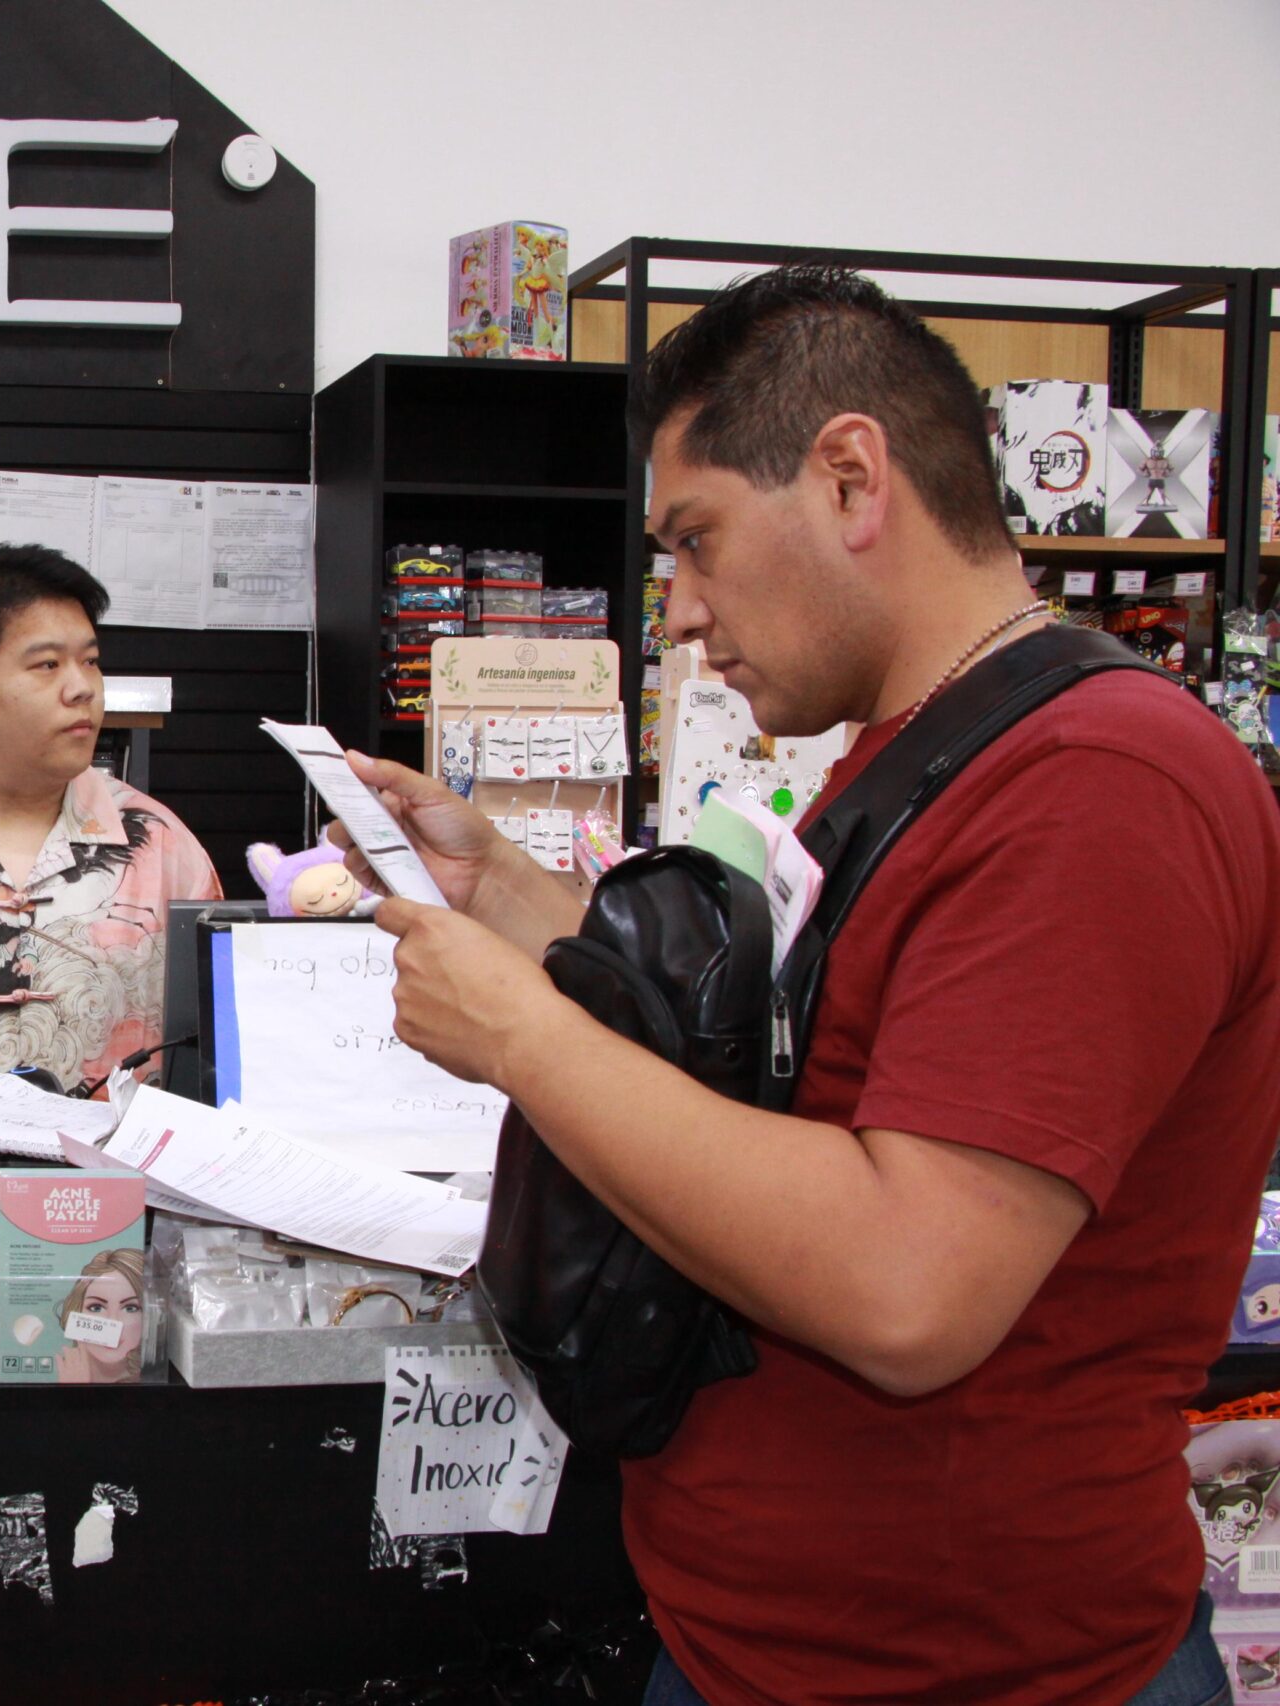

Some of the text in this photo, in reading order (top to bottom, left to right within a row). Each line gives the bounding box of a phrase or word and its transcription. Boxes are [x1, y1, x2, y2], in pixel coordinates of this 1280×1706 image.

[1140, 611, 1161, 624] UNO
[477, 666, 576, 683] Artesanía ingeniosa
[49, 1188, 92, 1200] ACNE
[43, 1198, 101, 1211] PIMPLE
[45, 1210, 98, 1222] PATCH
[76, 1320, 103, 1332] $35.00
[5, 1357, 18, 1368] 72
[413, 1373, 517, 1428] Acero
